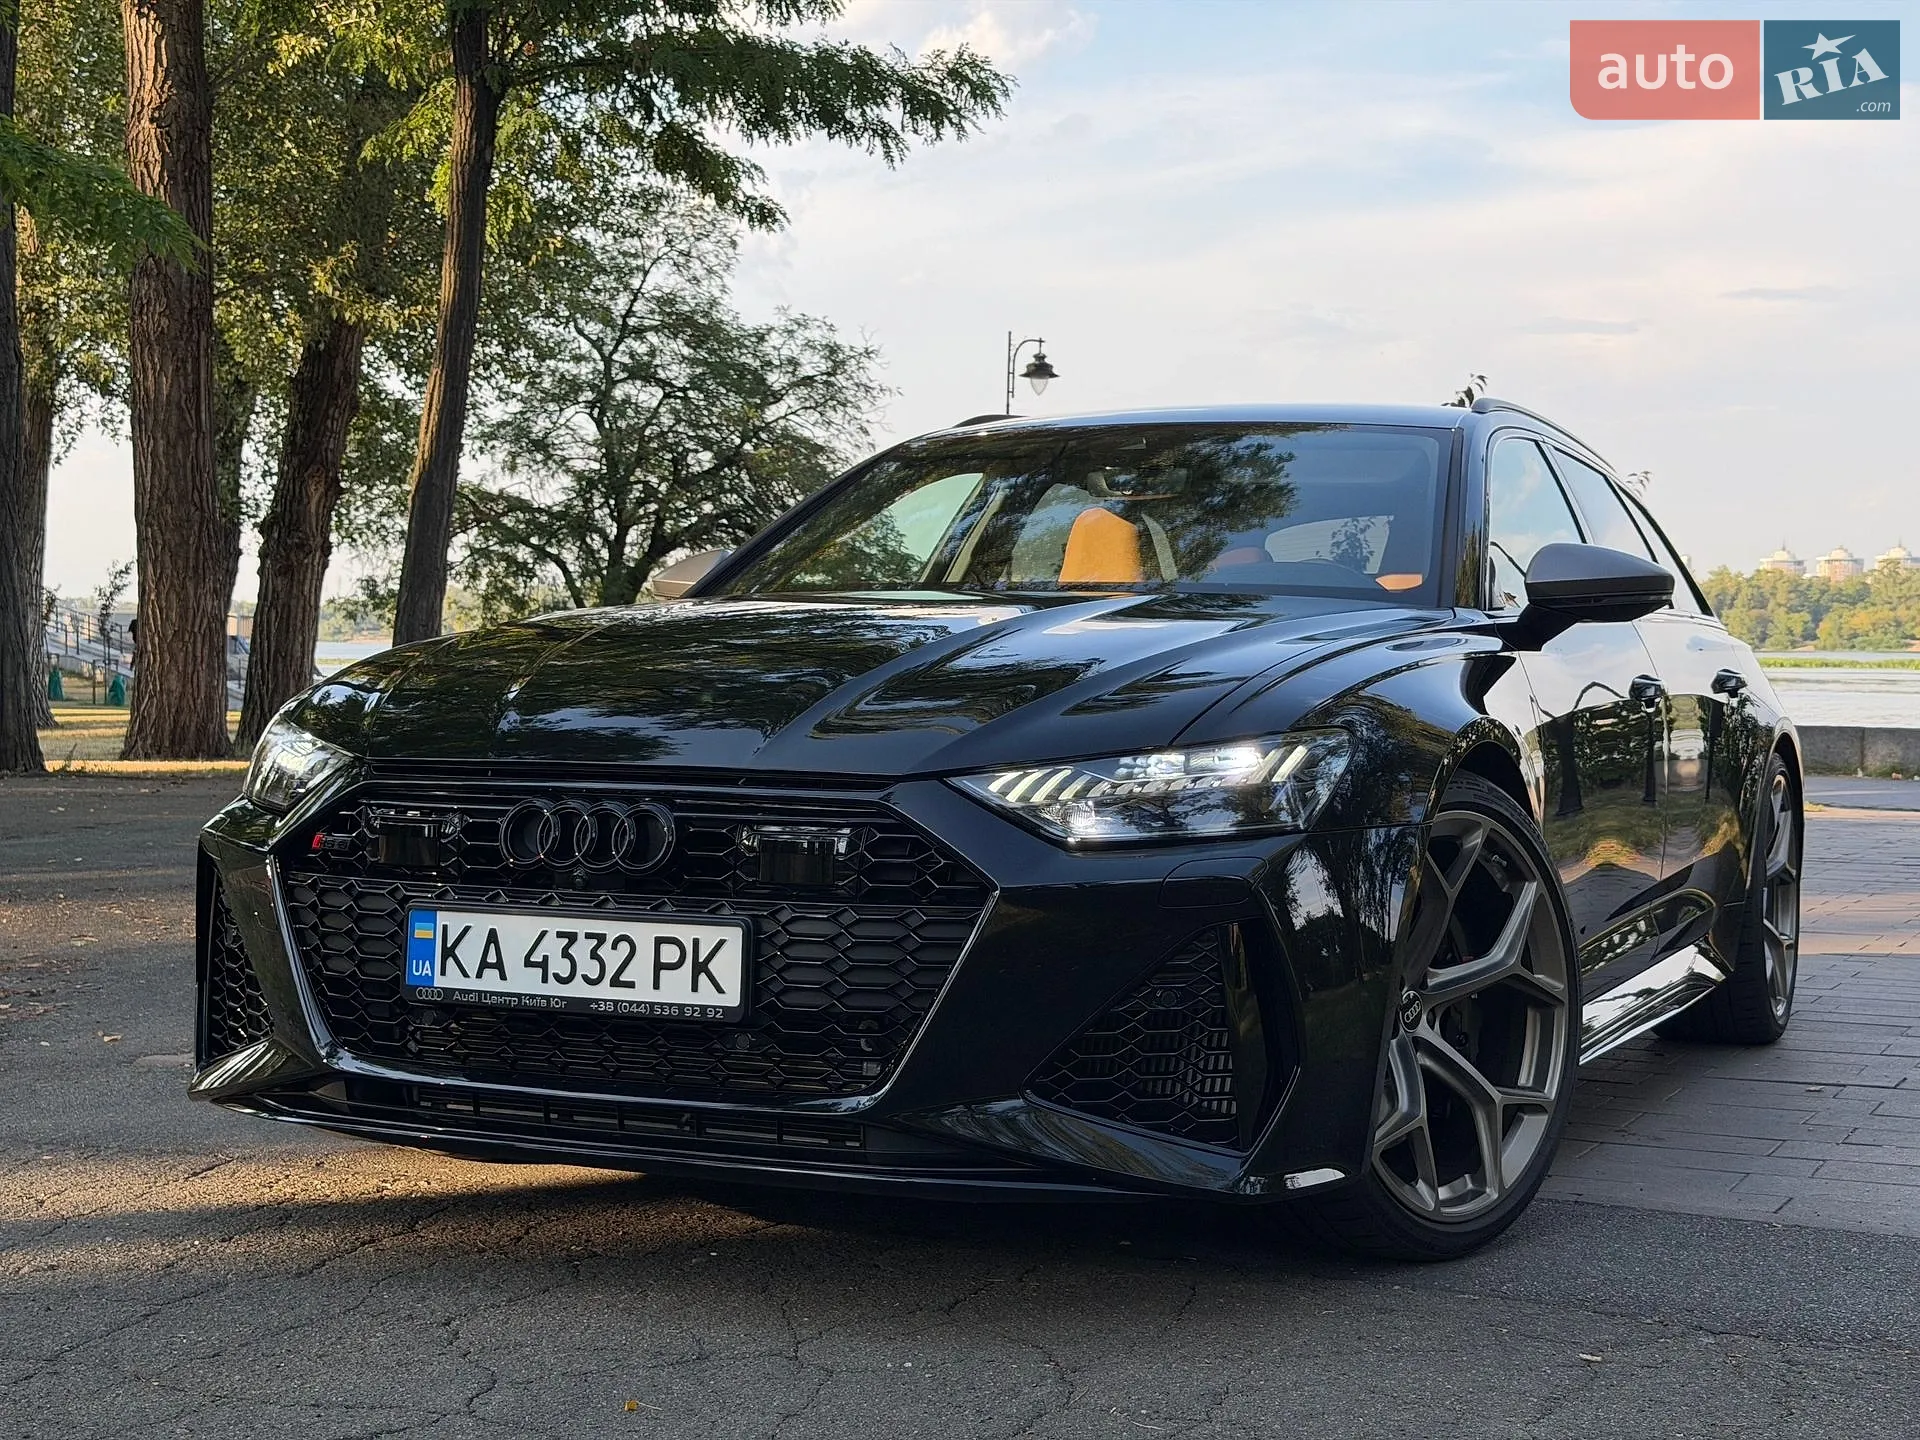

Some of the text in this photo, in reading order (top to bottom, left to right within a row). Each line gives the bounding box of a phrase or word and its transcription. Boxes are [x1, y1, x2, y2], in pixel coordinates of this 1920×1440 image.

[440, 924, 728, 994] KA 4332 PK
[413, 961, 432, 977] UA
[453, 991, 567, 1008] Audi Центр Київ Юг
[589, 1002, 724, 1018] +38 (044) 536 92 92
